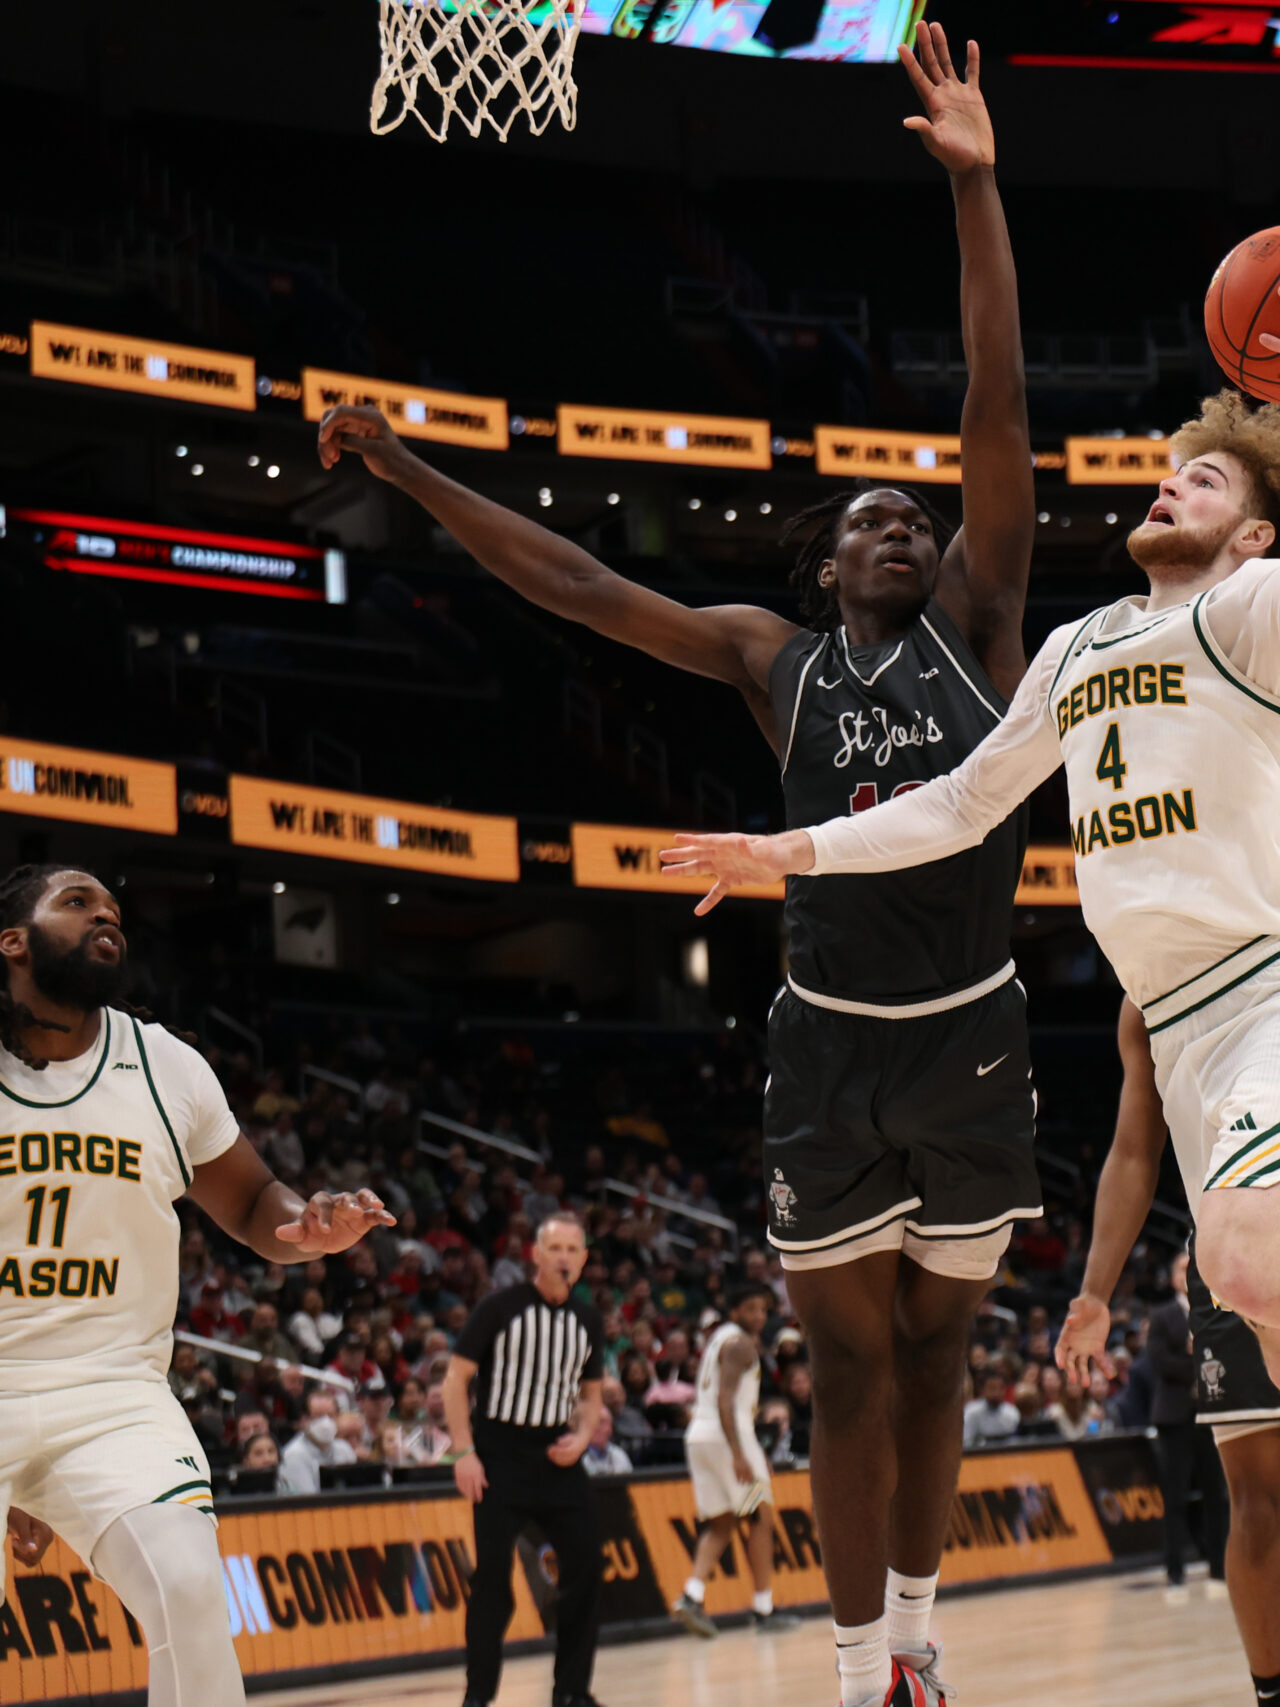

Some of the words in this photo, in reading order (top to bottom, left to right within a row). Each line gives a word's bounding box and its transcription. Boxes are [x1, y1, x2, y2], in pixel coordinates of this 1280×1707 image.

[171, 545, 297, 580] CHAMPIONSHIP
[1056, 662, 1188, 742] GEORGE
[1096, 721, 1127, 791] 4
[1070, 788, 1198, 857] MASON
[111, 1062, 138, 1070] A10
[24, 1184, 72, 1249] 11
